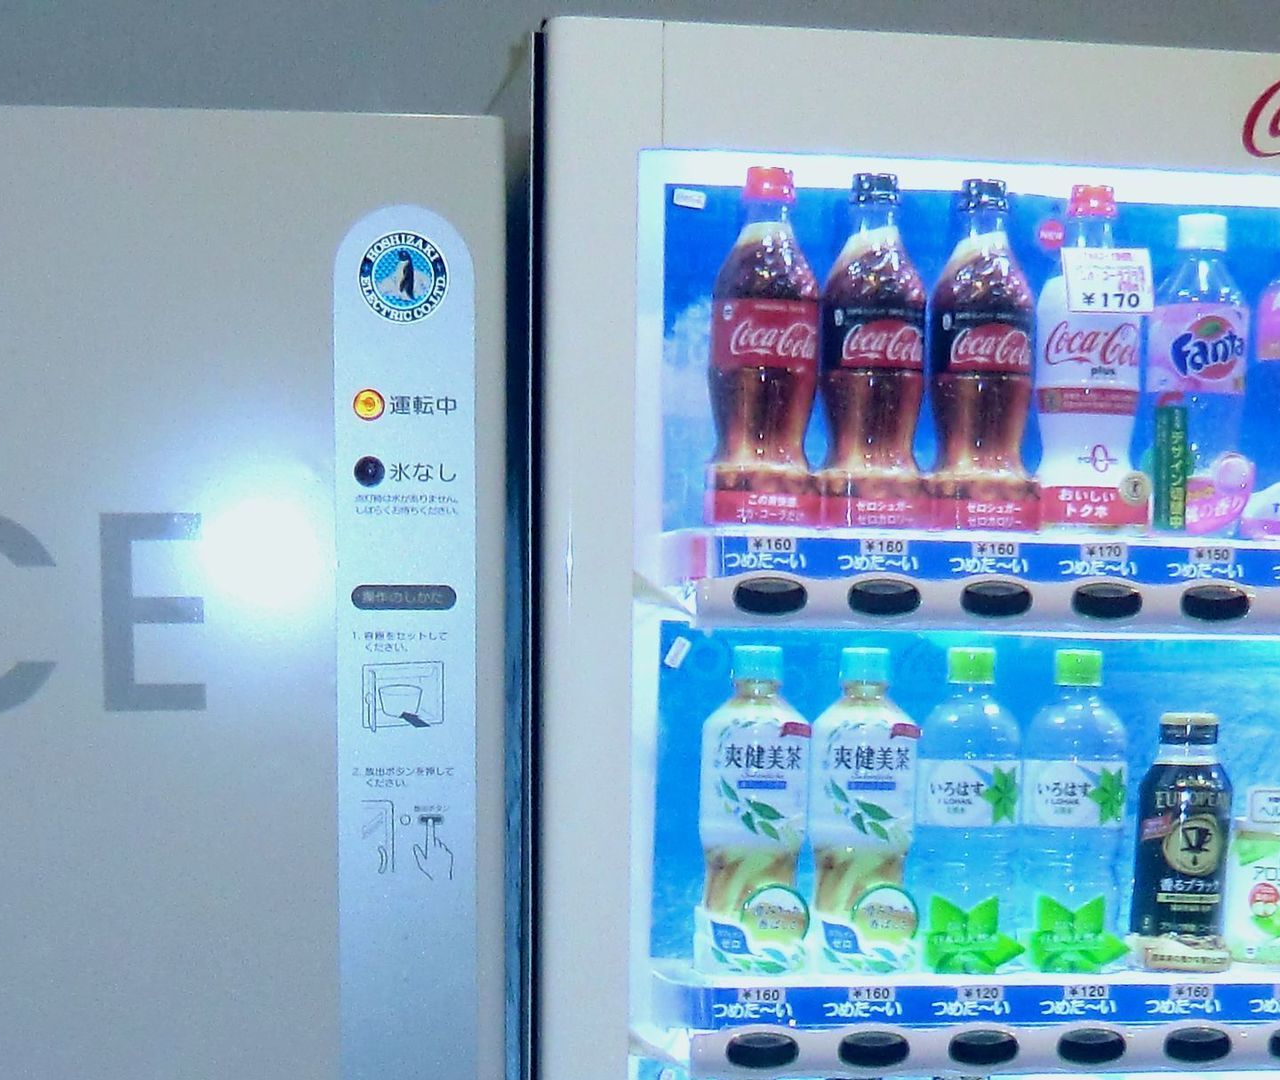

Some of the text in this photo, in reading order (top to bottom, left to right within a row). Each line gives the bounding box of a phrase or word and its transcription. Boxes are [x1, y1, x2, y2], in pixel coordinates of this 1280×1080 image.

[366, 232, 438, 261] HOSHIZAKI
[1082, 293, 1140, 308] ¥170
[1171, 332, 1245, 379] Fanta
[390, 395, 456, 416] 運転中
[390, 463, 458, 482] 氷なし
[1058, 490, 1115, 502] おいしい
[1065, 504, 1109, 517] トクホ
[754, 538, 792, 551] ¥160
[977, 543, 1015, 556] ¥160
[1086, 546, 1122, 558] ¥170
[724, 745, 802, 770] 爽健美茶
[834, 746, 910, 771] 爽健美茶
[931, 780, 984, 797] いろはす
[1037, 780, 1092, 797] いろはす
[743, 989, 780, 1002] ¥160
[853, 988, 890, 1001] ¥160
